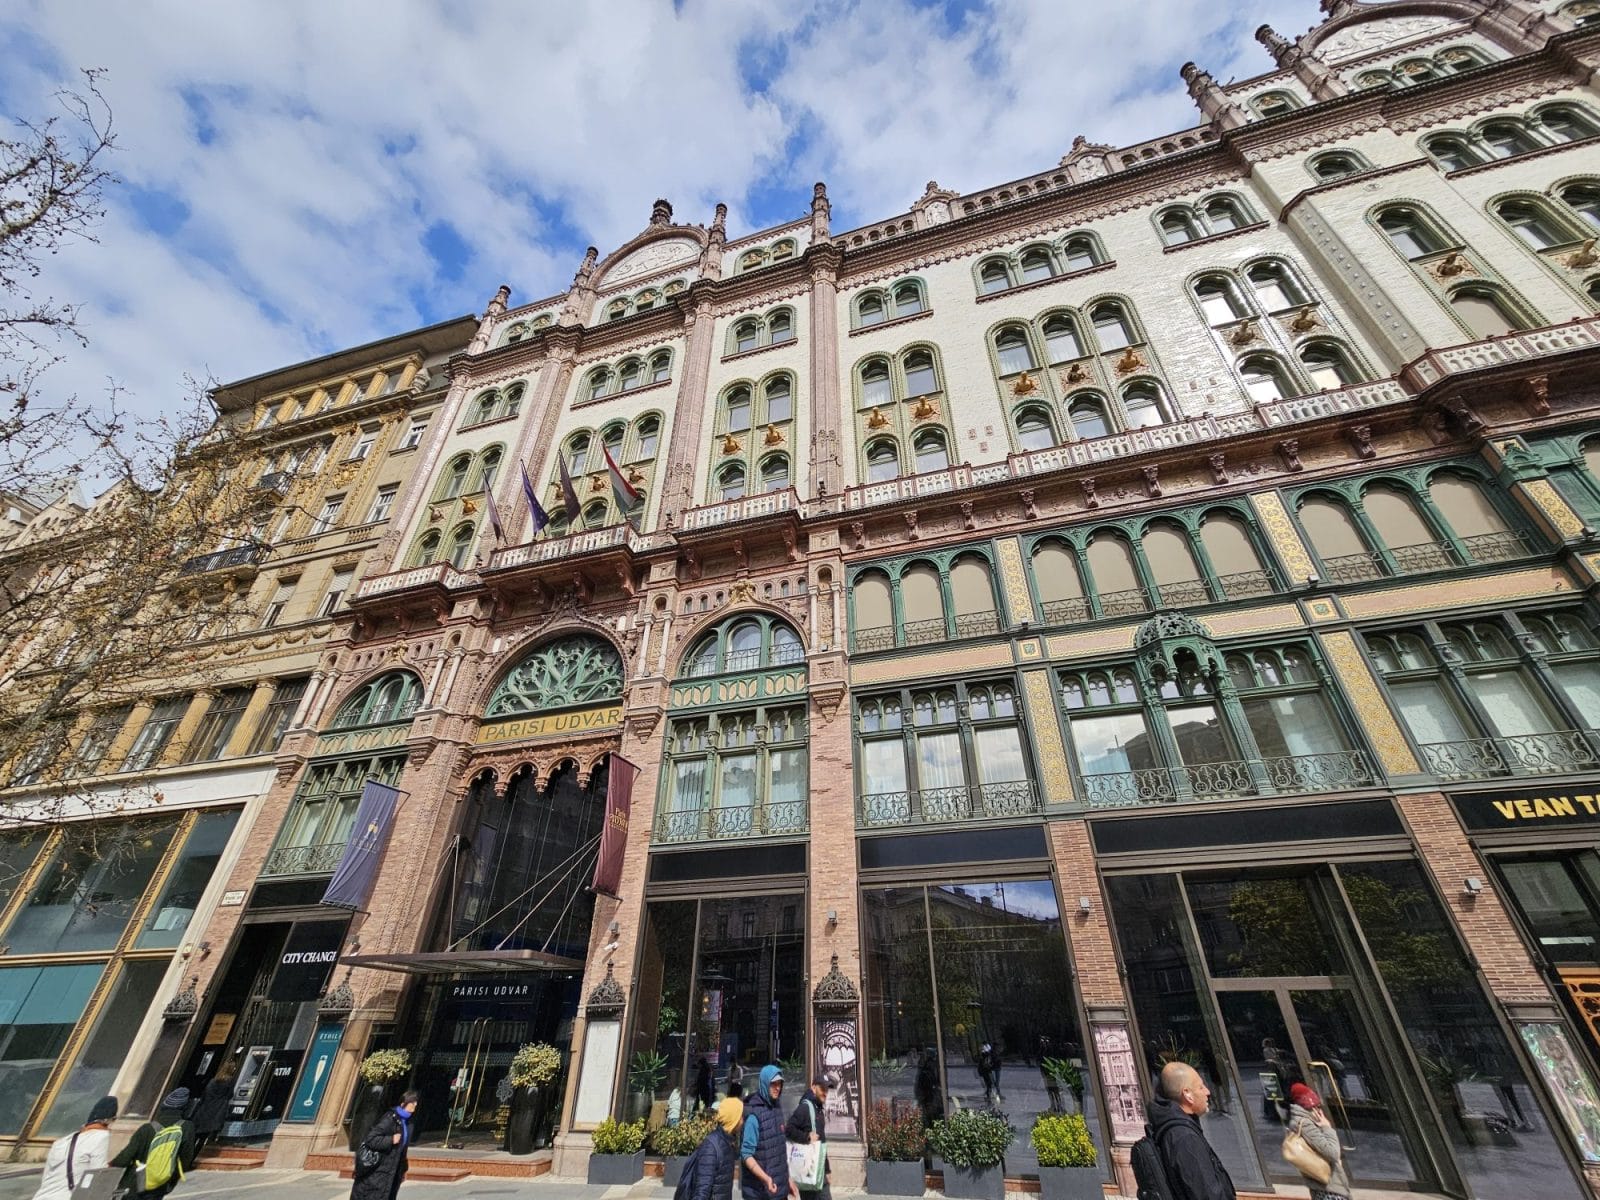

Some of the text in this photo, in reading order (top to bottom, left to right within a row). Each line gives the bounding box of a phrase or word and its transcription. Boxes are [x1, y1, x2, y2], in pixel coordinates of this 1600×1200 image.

[485, 709, 620, 740] PARISI UDVAR
[1492, 794, 1600, 819] VEAN T
[282, 952, 304, 964] CITY
[453, 985, 528, 996] PARISI UDVAR
[273, 1067, 292, 1076] ATM
[231, 1106, 246, 1114] ATM
